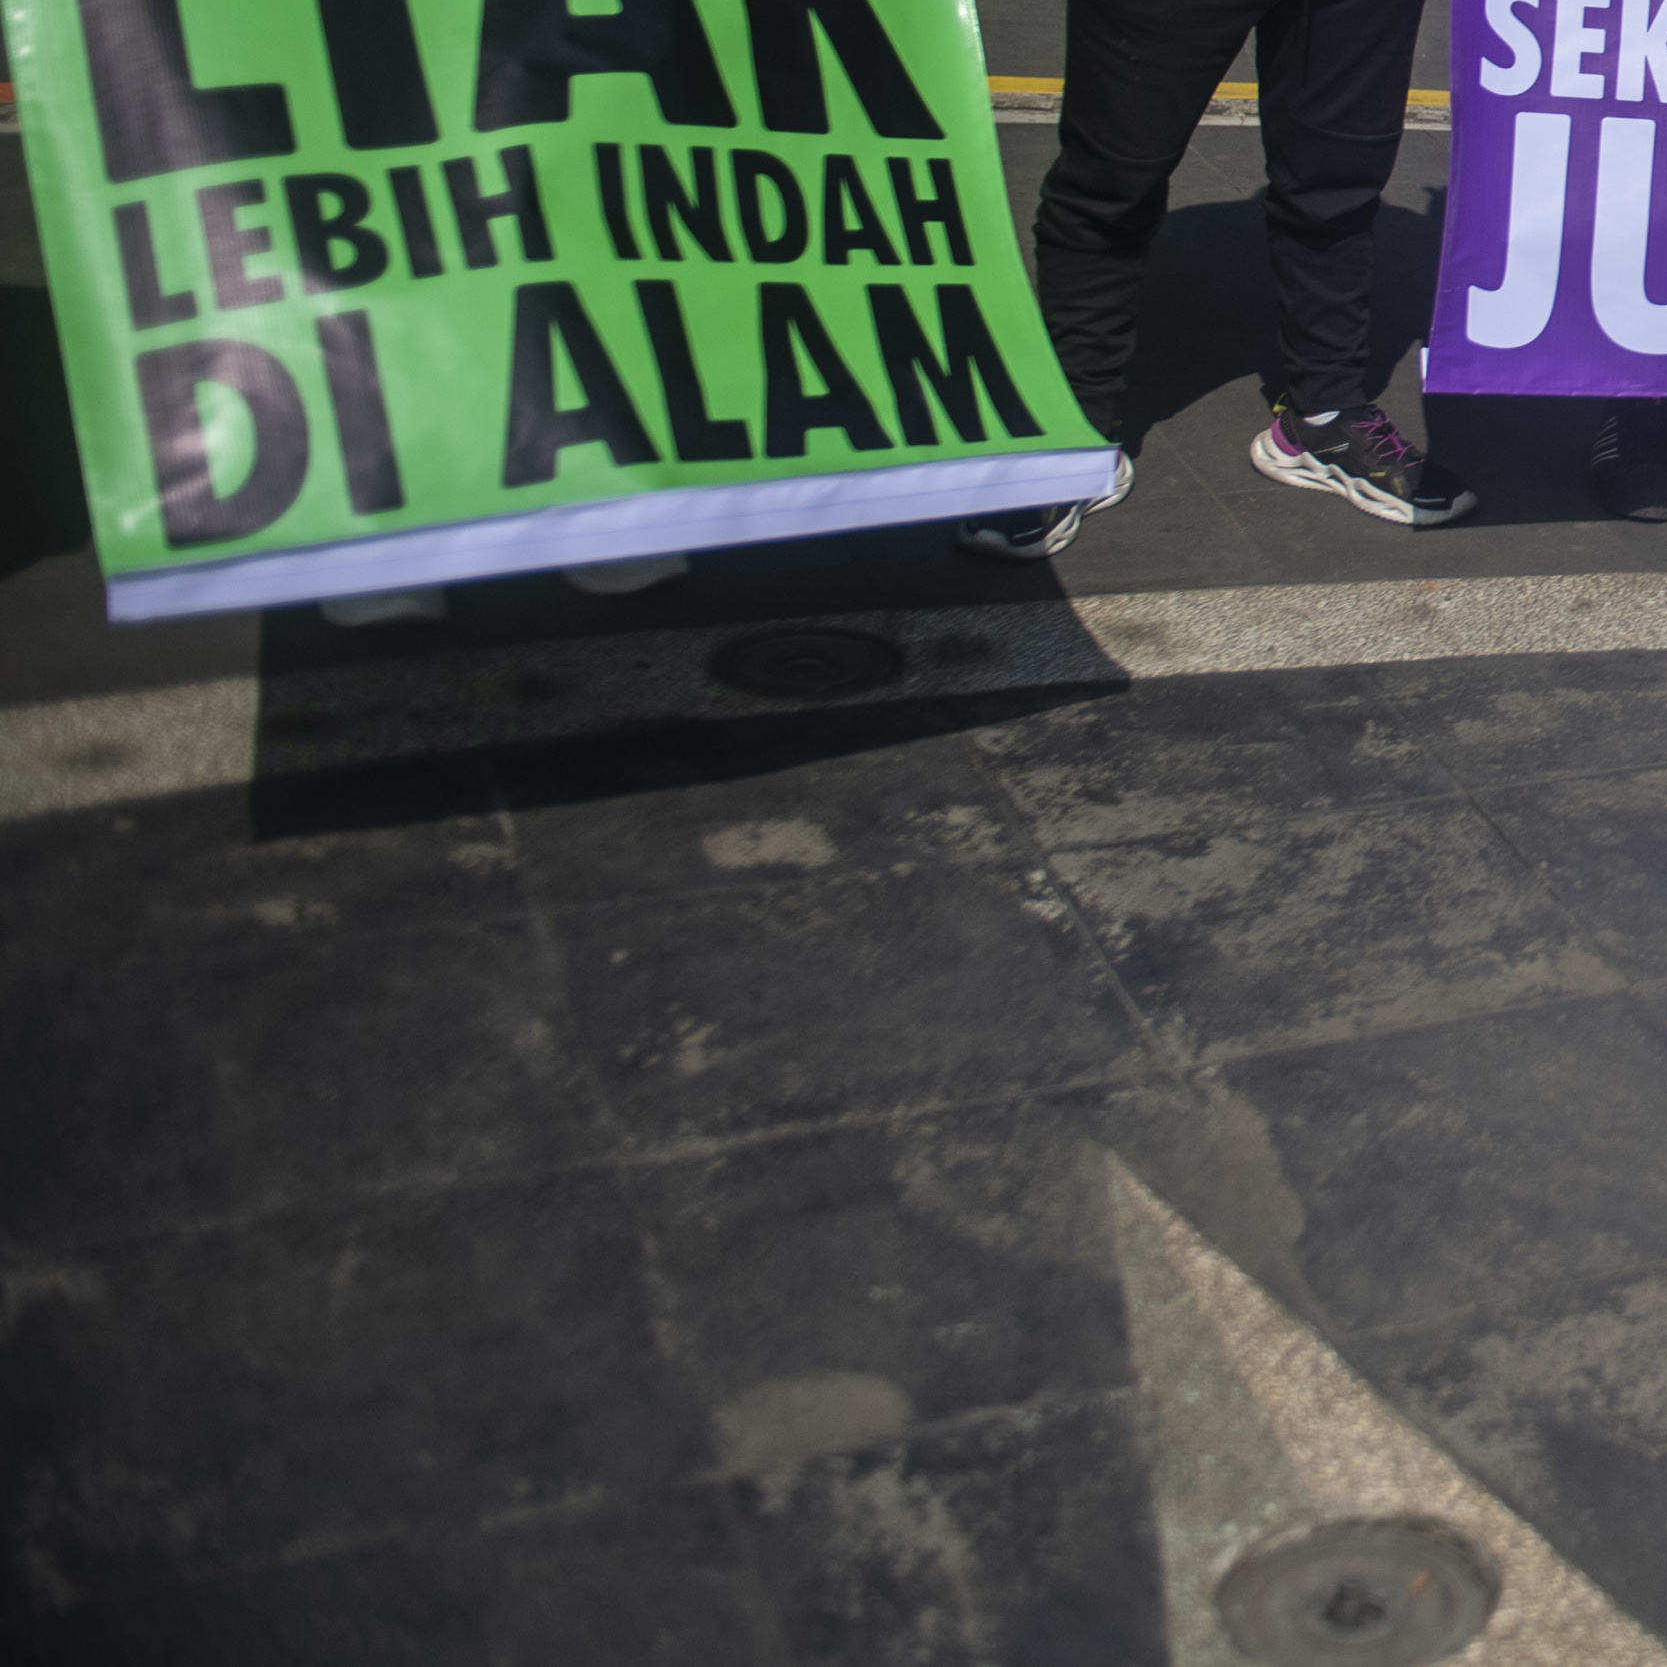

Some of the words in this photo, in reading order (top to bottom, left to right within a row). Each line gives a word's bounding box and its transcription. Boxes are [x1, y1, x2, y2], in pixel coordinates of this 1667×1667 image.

[110, 142, 555, 331] LEBIH
[599, 141, 974, 266] INDAH
[134, 310, 406, 550] DI
[500, 280, 1046, 489] ALAM
